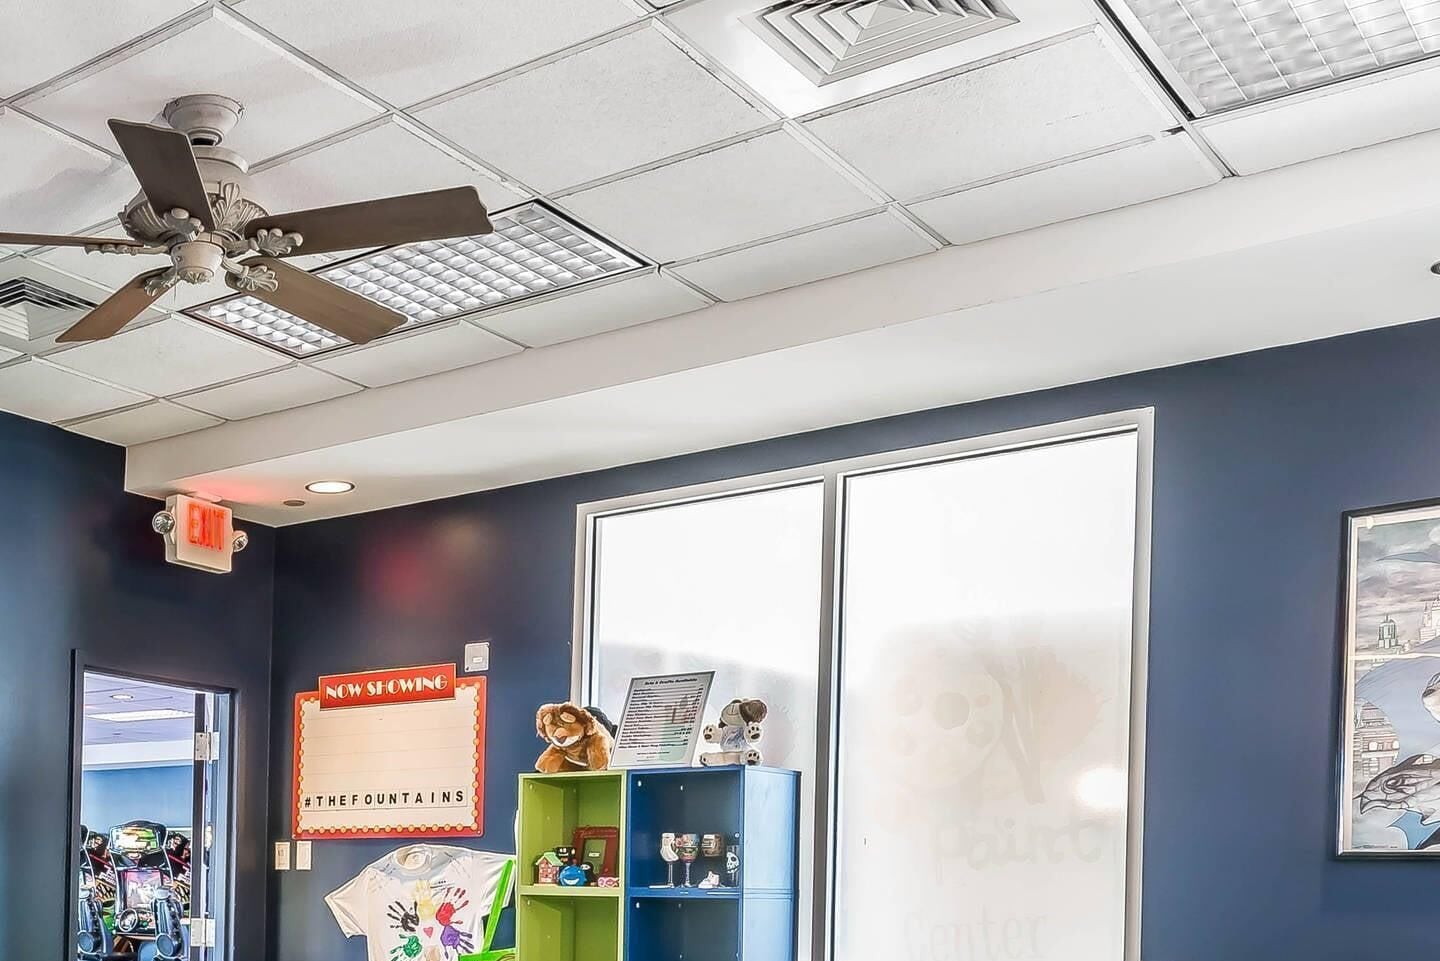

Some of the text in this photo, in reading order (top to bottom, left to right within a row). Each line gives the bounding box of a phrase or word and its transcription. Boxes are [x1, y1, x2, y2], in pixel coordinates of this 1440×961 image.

[188, 503, 226, 551] EXIT
[325, 674, 449, 700] NOW SHOWING
[304, 790, 465, 808] #THEFOUNTAINS
